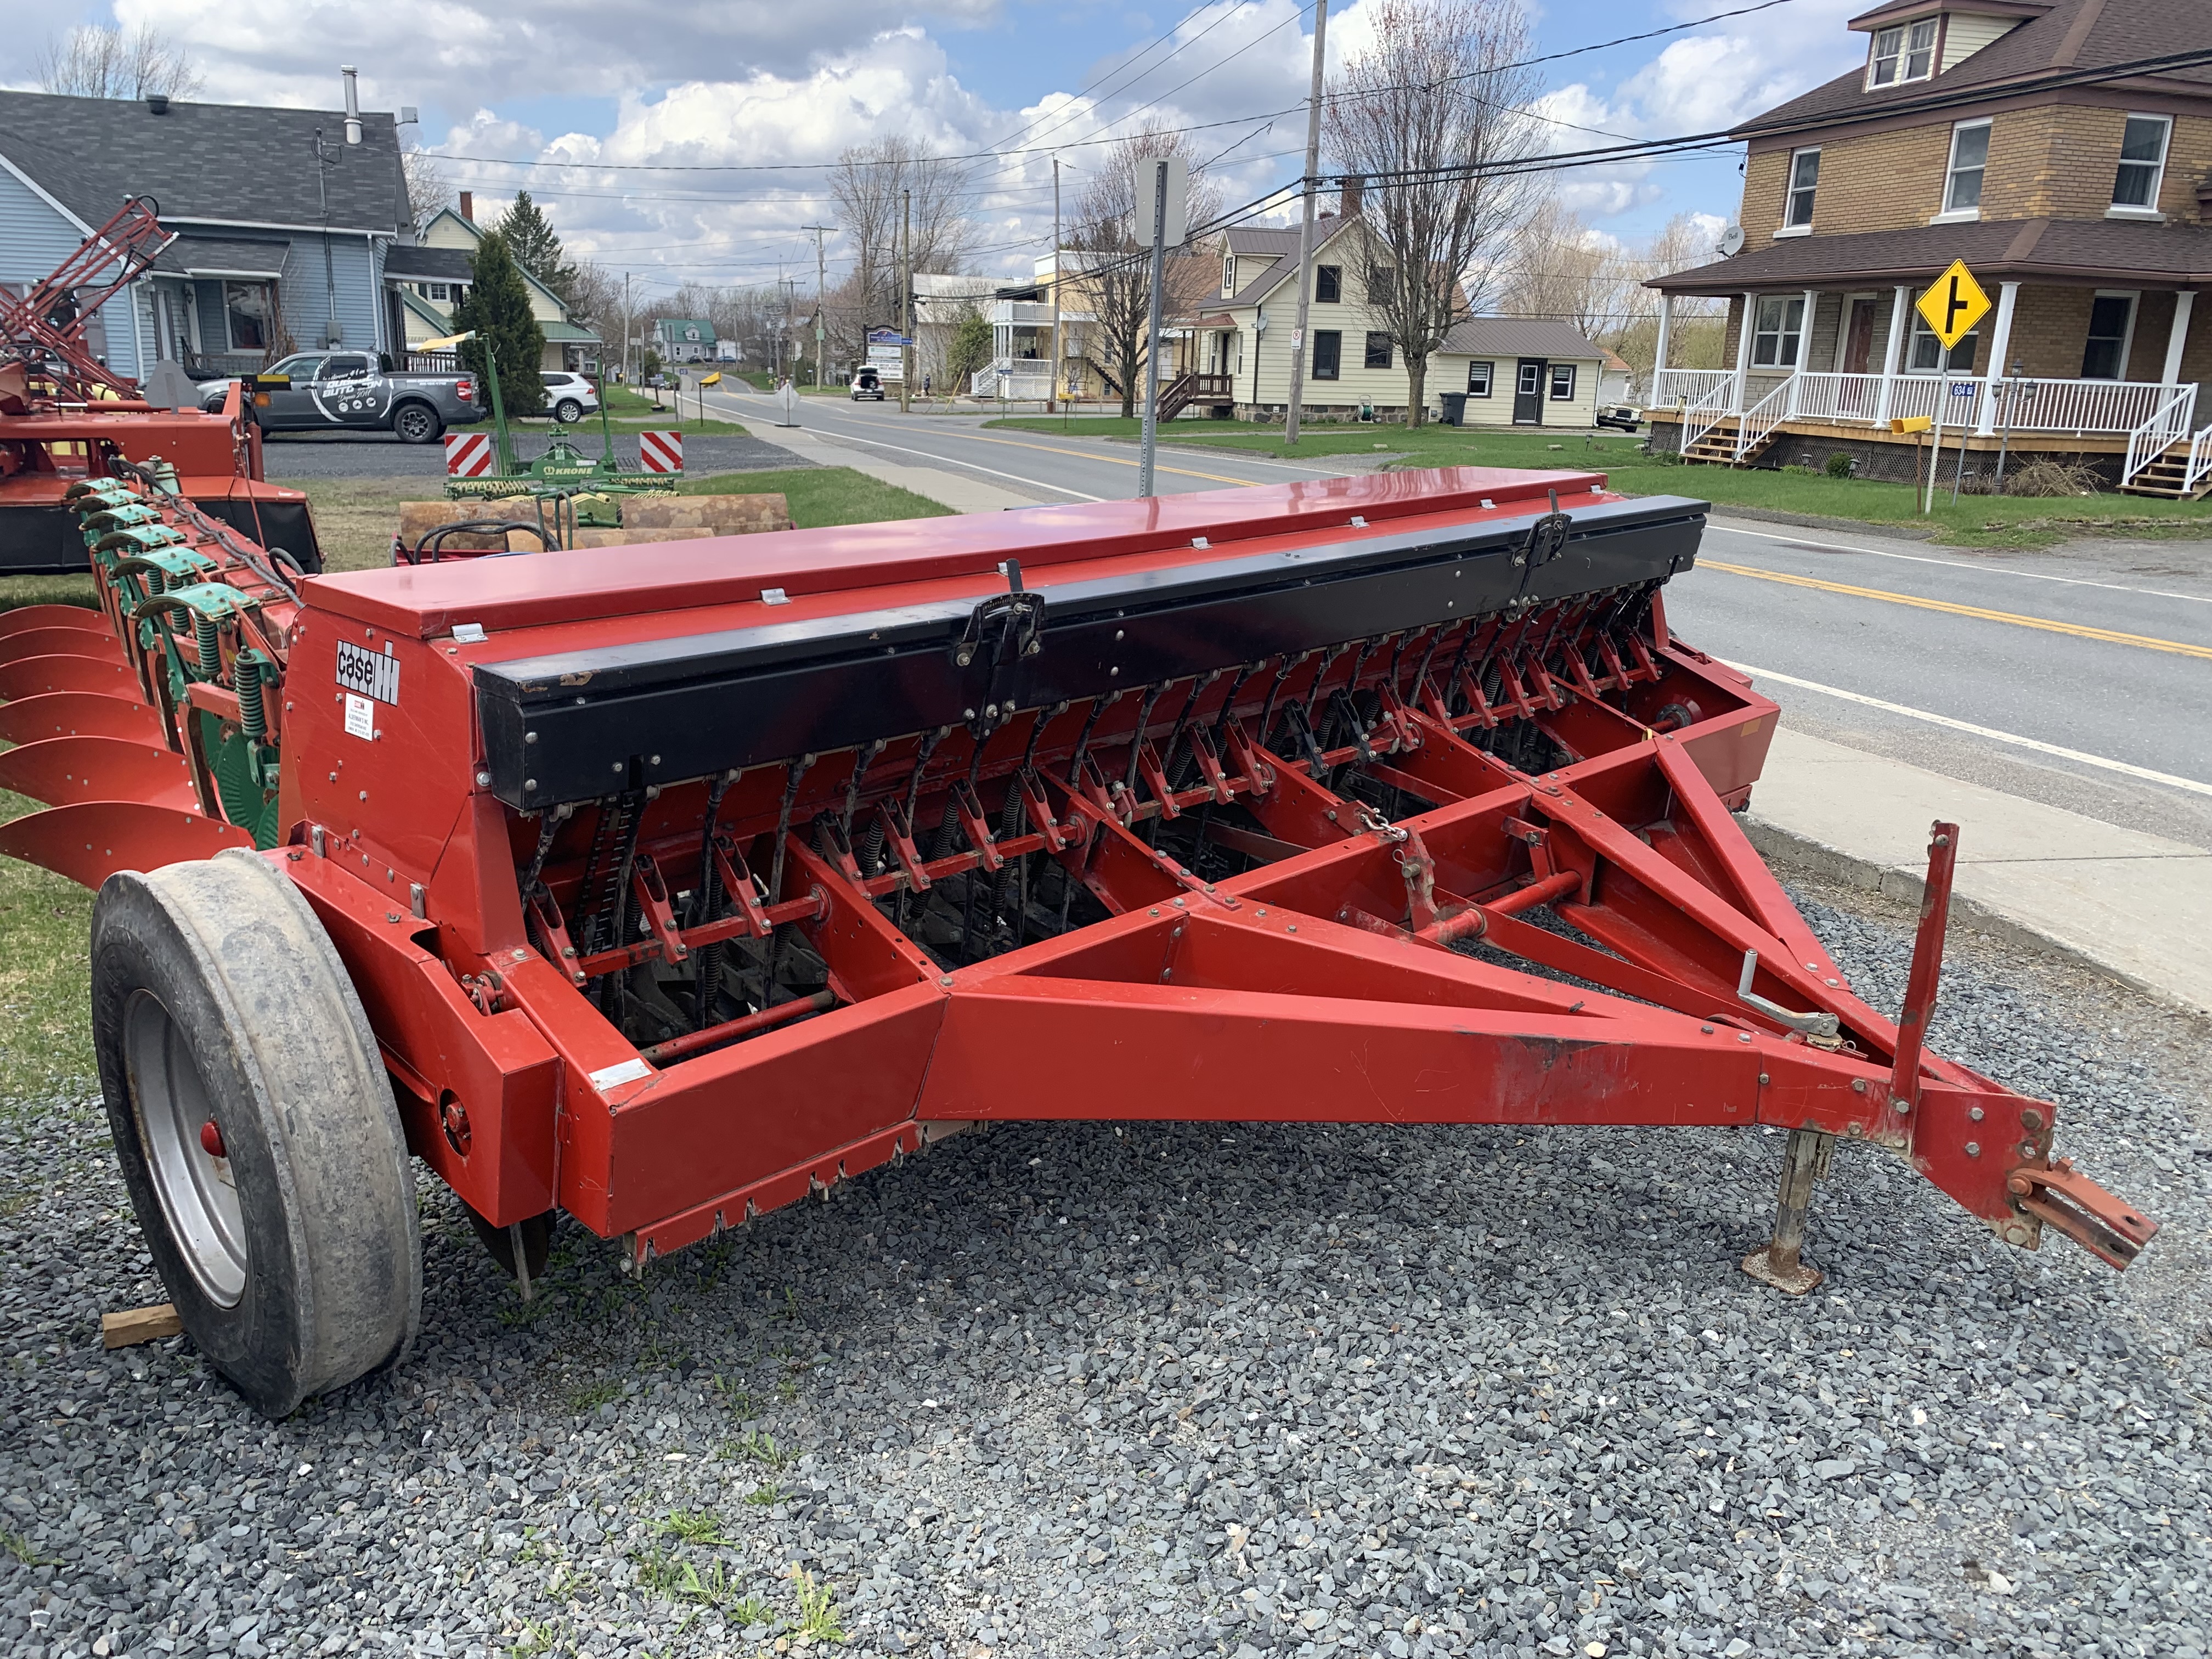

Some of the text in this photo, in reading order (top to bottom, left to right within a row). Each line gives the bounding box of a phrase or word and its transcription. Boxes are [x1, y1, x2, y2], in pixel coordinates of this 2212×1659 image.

[1729, 232, 1738, 240] Bell
[322, 385, 355, 398] AUTO
[1954, 385, 1966, 396] 634
[555, 467, 594, 475] KRONE
